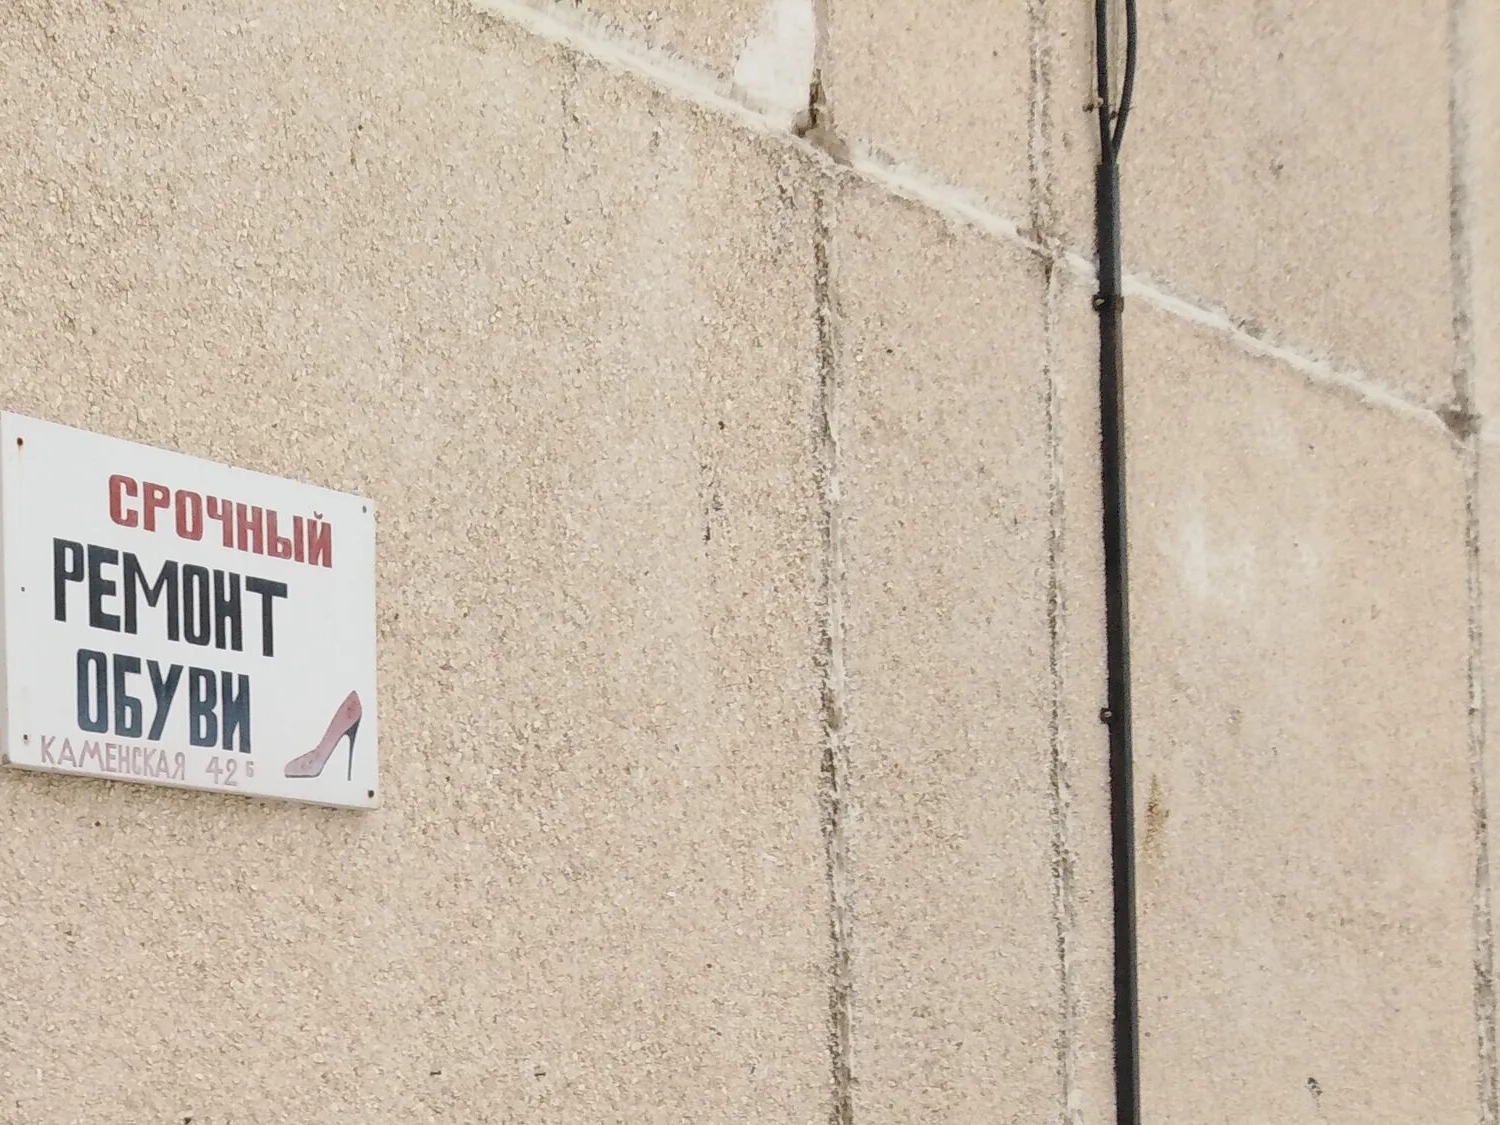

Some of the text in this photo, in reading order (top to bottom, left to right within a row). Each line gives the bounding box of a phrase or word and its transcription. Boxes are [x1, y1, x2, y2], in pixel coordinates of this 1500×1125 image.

[108, 473, 333, 569] СРОЧНЫЙ
[52, 536, 289, 658] РЕМОНТ
[76, 647, 252, 754] ОБУВИ
[40, 734, 186, 781] КАМЕНСКАЯ
